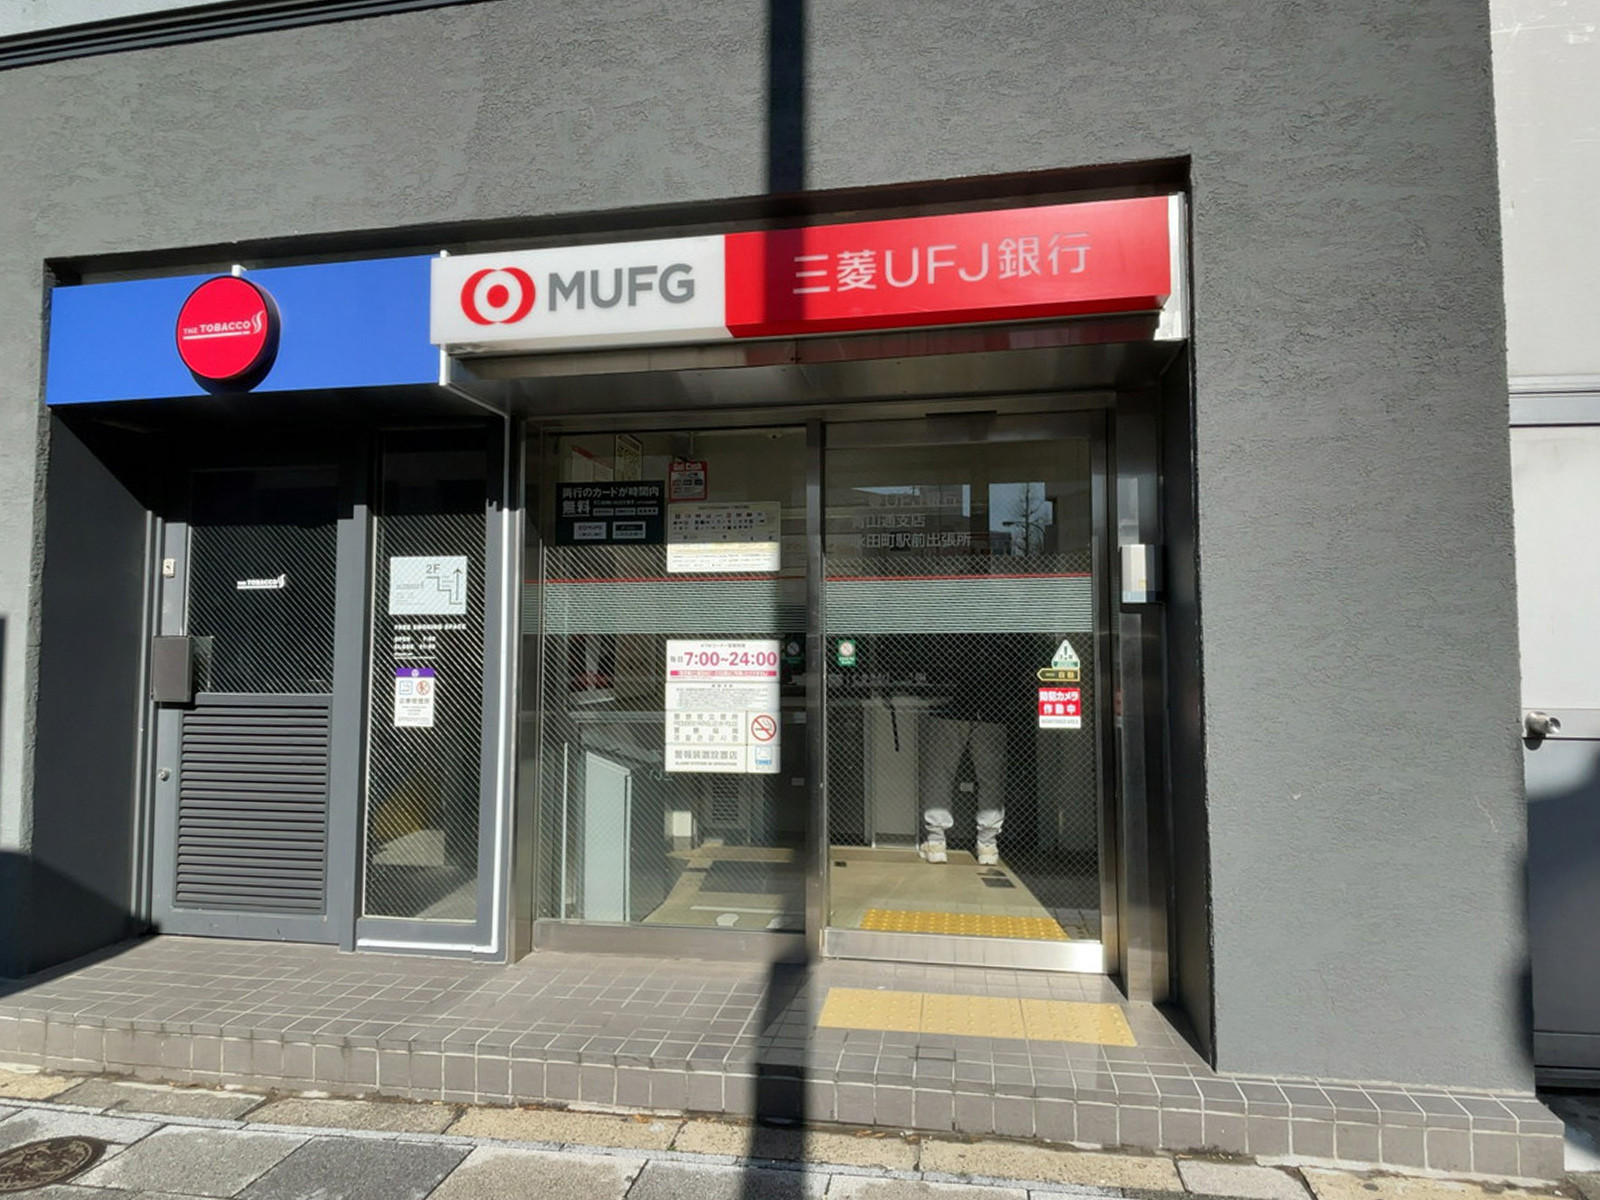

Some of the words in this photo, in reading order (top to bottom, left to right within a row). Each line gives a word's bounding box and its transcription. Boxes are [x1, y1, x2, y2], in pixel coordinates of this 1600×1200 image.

[792, 231, 1092, 296] 三菱UFJ銀行
[548, 263, 695, 312] MUFG
[183, 326, 198, 335] THE
[199, 320, 251, 333] TOBACCO
[562, 499, 591, 515] 無料
[425, 563, 441, 574] 2F
